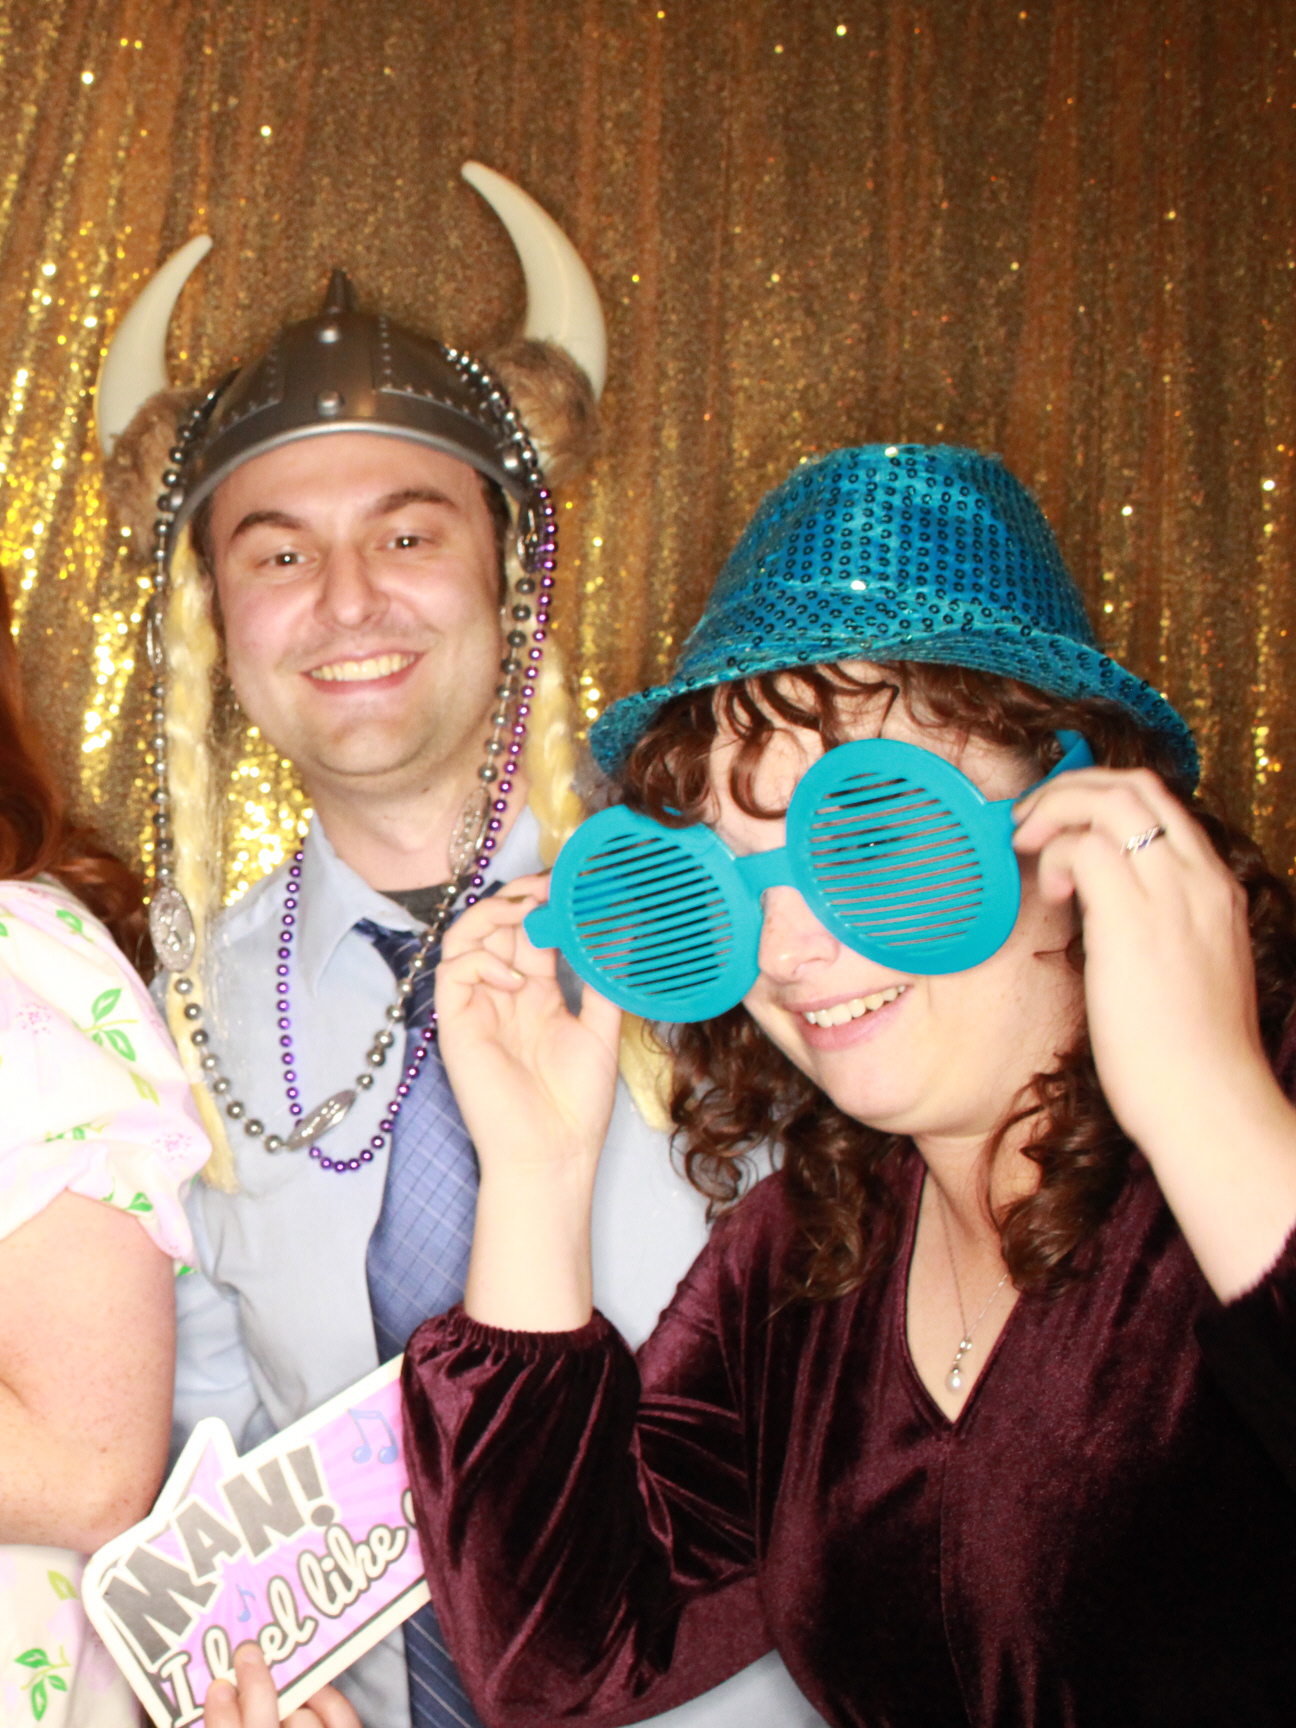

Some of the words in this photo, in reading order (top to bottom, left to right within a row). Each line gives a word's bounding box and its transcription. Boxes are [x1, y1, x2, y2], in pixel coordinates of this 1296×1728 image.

[102, 1445, 336, 1663] MAN!
[160, 1653, 204, 1727] I
[298, 1525, 407, 1617] like
